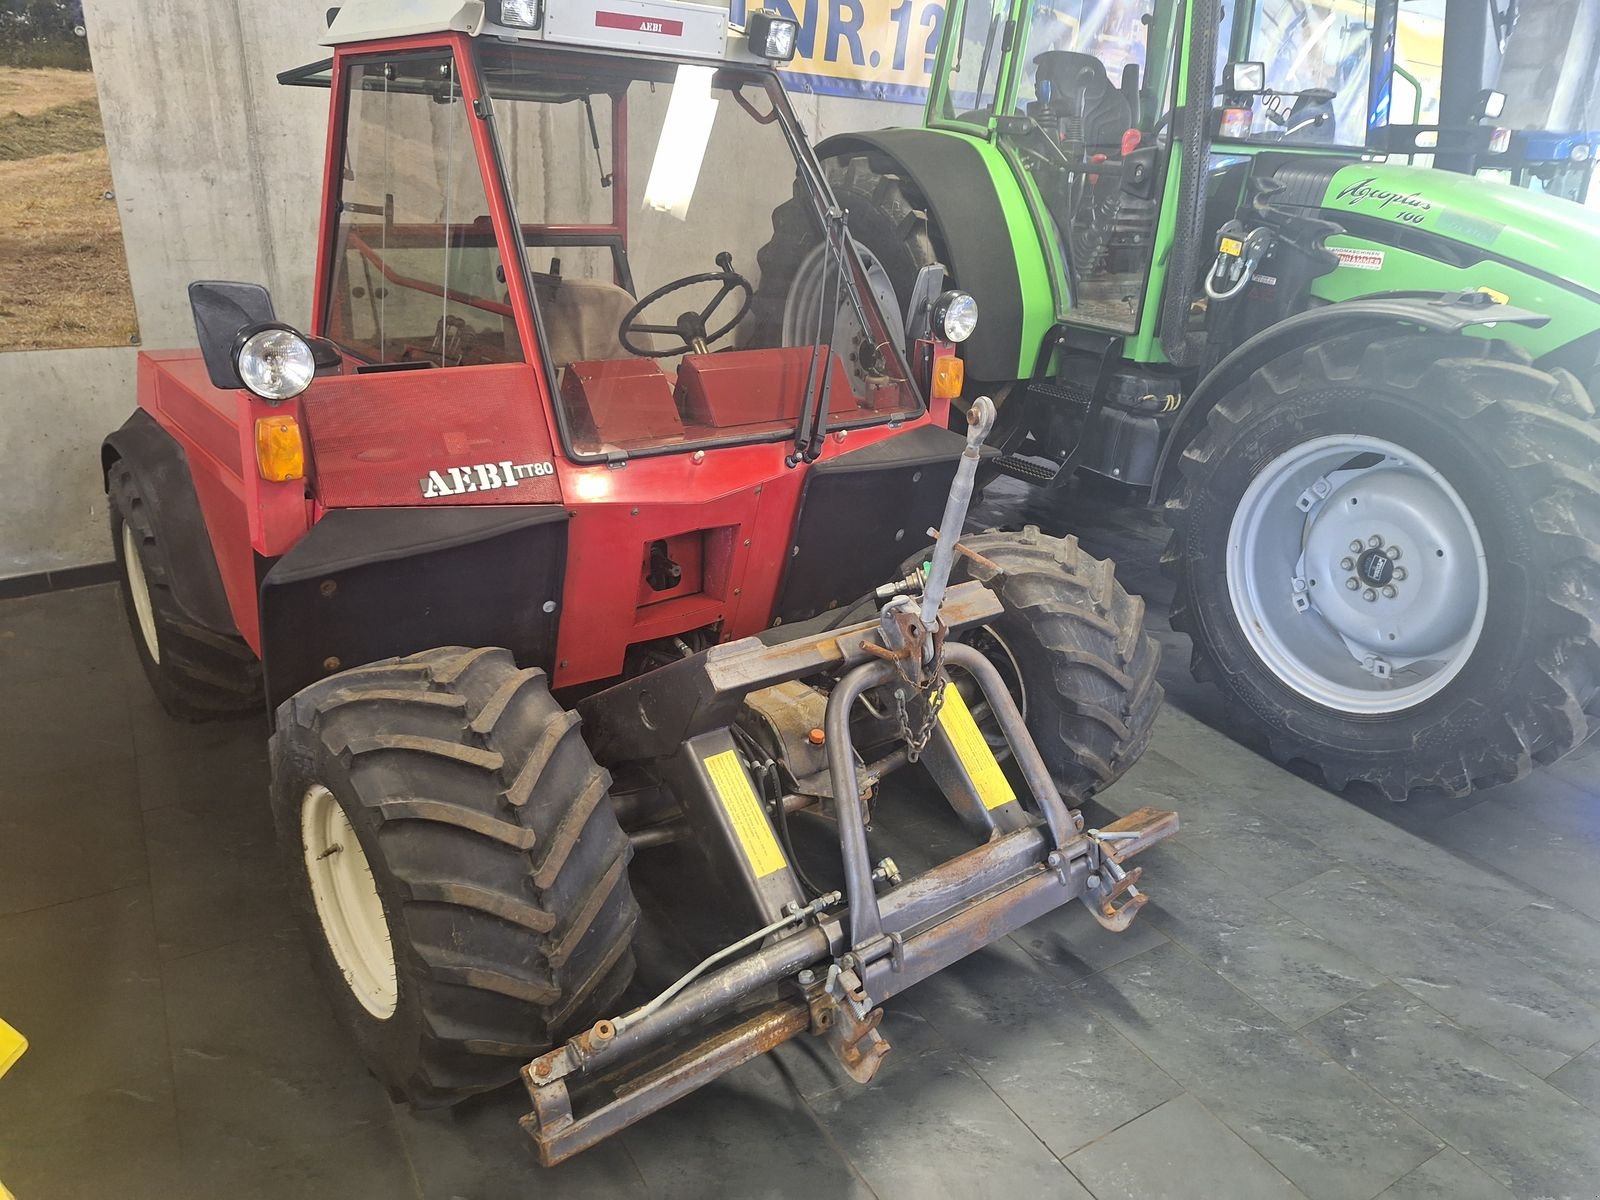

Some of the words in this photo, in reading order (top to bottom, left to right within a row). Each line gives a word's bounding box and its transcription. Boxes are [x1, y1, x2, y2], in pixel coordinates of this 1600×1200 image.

[640, 21, 662, 32] AEBI
[1336, 177, 1431, 210] Agroplus
[1395, 211, 1425, 224] 100
[423, 461, 519, 498] AEBI
[513, 462, 554, 478] TT80
